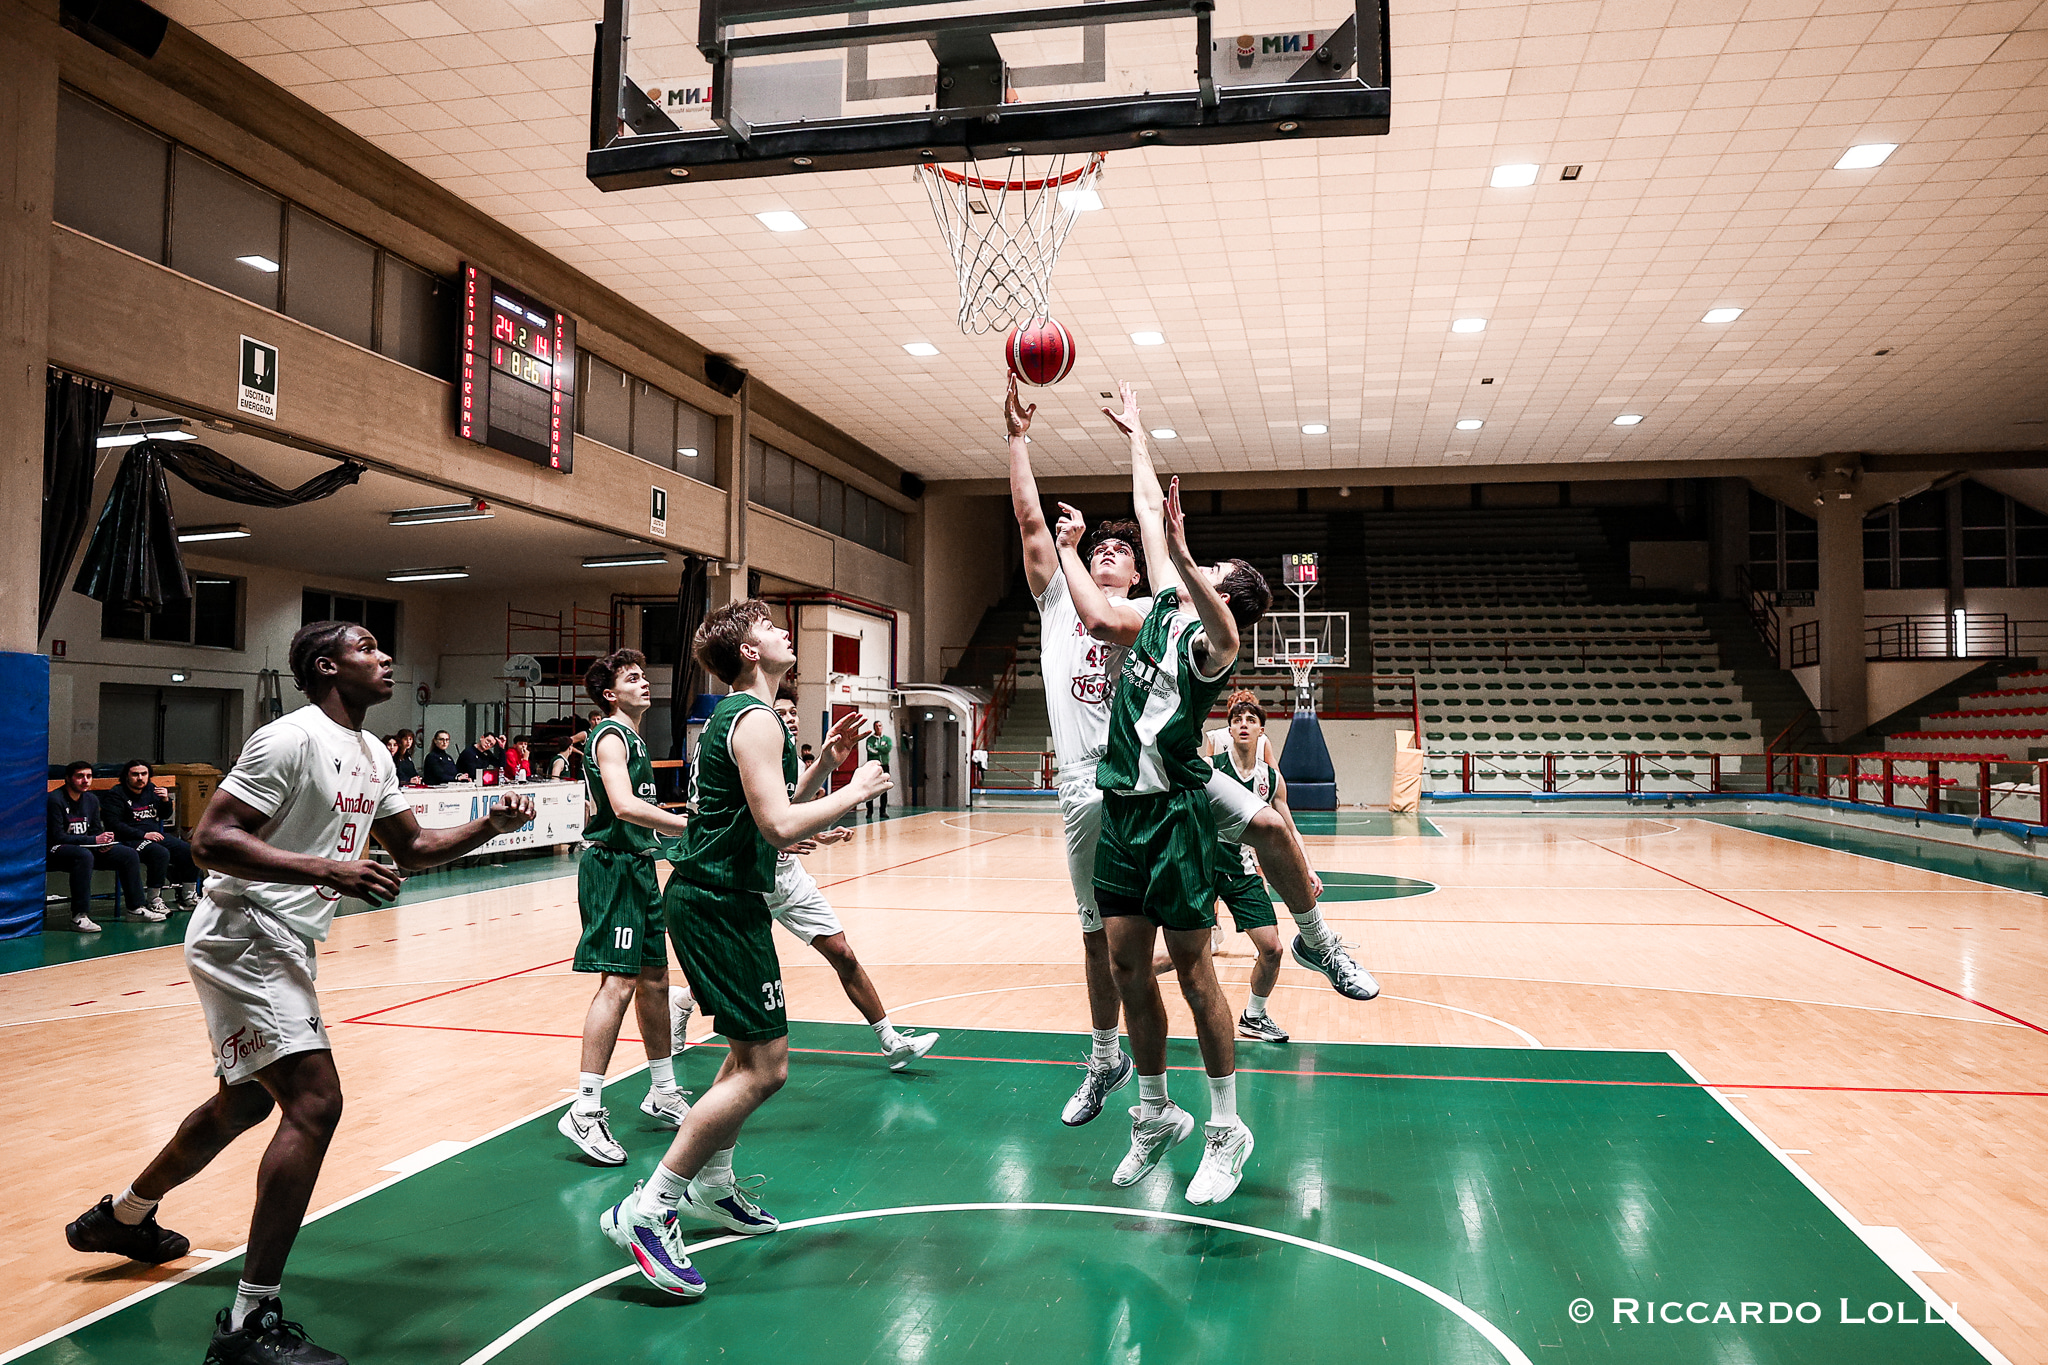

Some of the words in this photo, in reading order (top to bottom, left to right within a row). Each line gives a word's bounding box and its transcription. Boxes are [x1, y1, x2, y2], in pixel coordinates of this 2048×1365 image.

[468, 281, 476, 293] 5
[467, 295, 475, 308] 6
[466, 338, 474, 351] 9
[495, 314, 514, 342] 24
[519, 328, 527, 348] 2
[535, 334, 549, 358] 14
[497, 347, 503, 365] 1
[544, 369, 549, 385] 1
[245, 389, 264, 402] USCITA
[265, 395, 271, 404] DI
[241, 399, 273, 416] EMERGENZA
[1299, 565, 1317, 582] 14
[614, 926, 633, 950] 10
[761, 979, 785, 1011] 33
